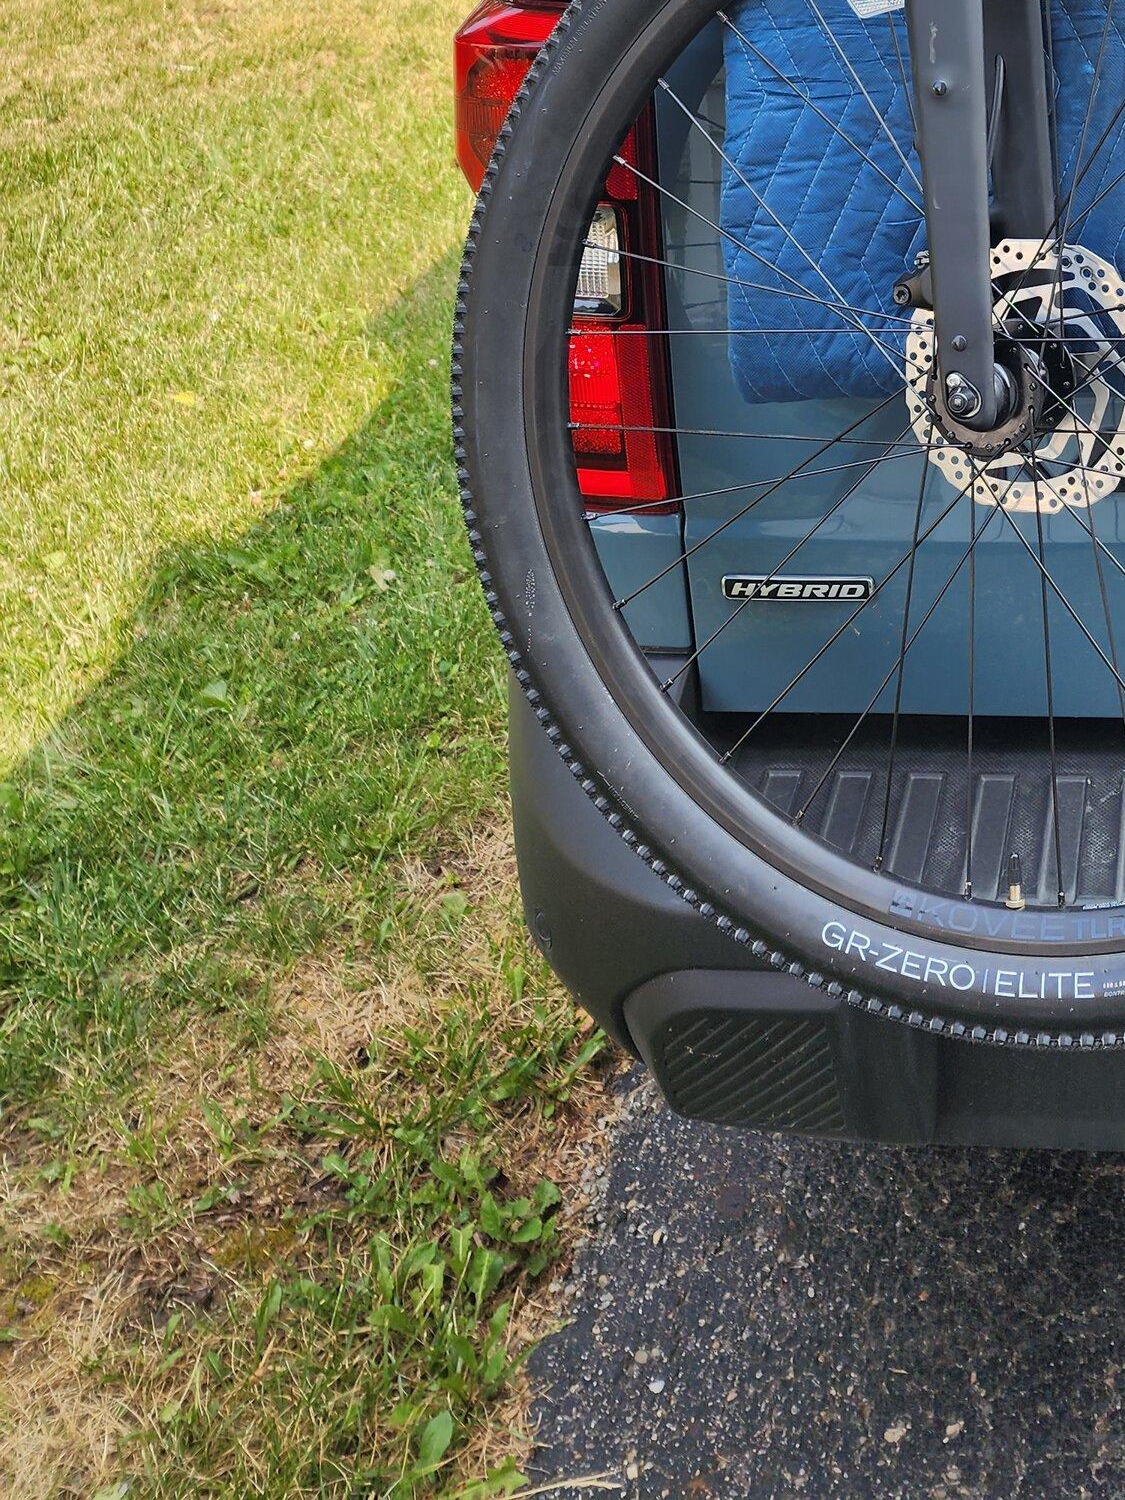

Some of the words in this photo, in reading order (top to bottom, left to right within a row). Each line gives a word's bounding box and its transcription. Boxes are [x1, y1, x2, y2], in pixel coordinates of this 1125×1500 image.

[730, 582, 866, 598] HYBRID
[914, 896, 1064, 941] KOVEE
[821, 920, 976, 993] GR-ZERO
[994, 969, 1096, 999] ELITE
